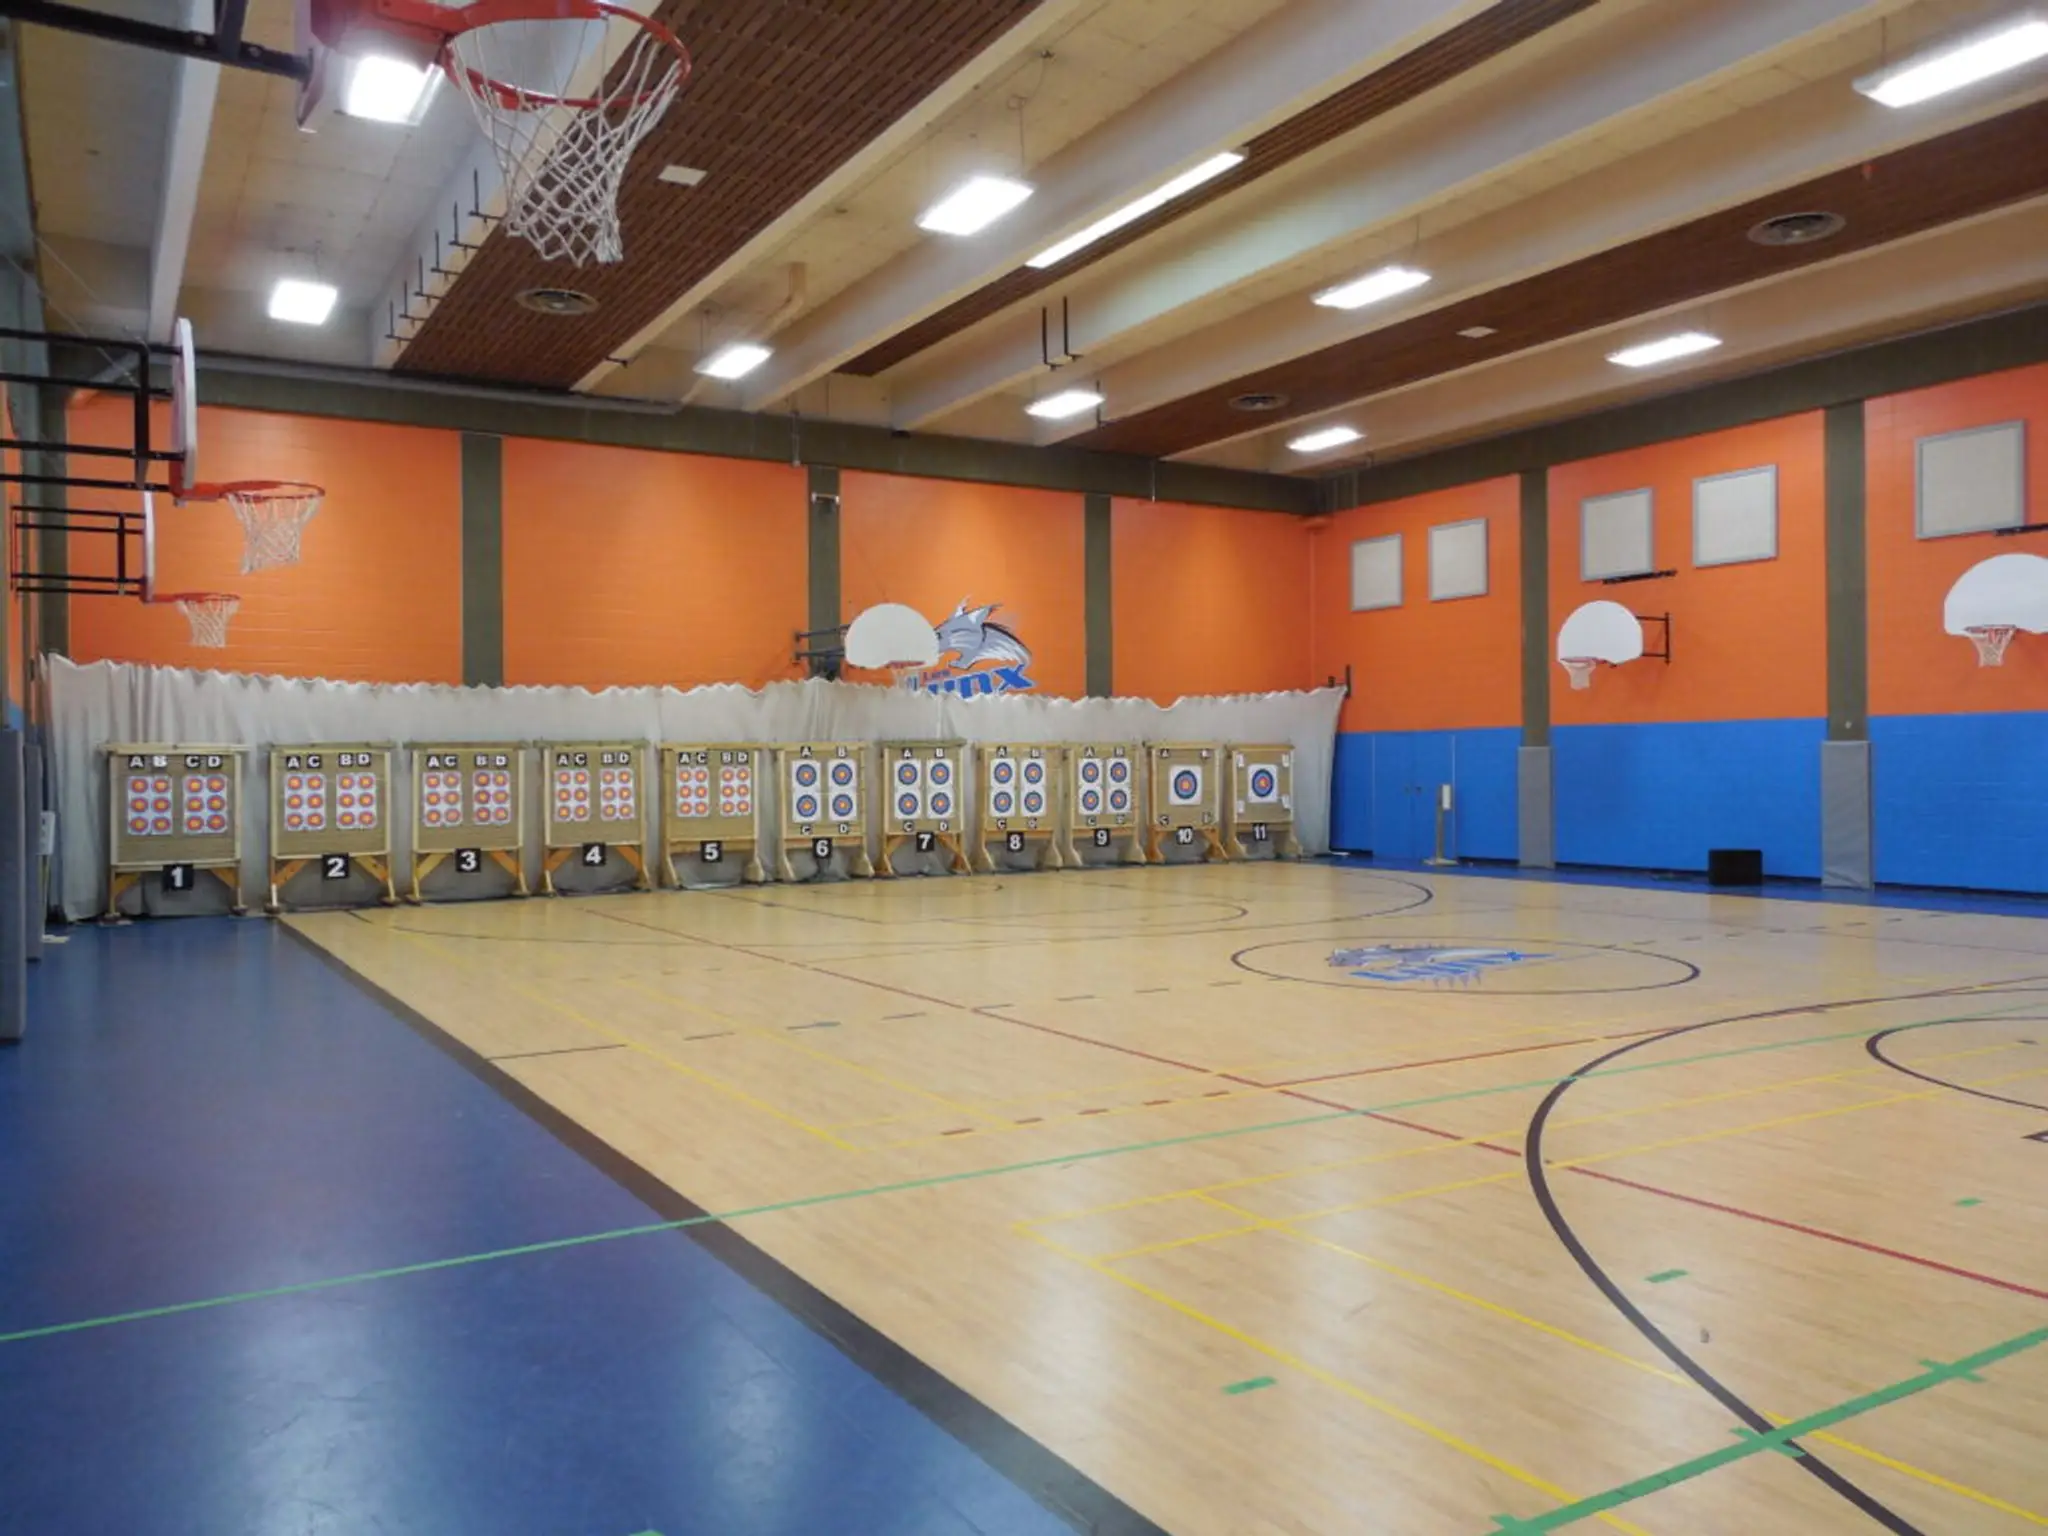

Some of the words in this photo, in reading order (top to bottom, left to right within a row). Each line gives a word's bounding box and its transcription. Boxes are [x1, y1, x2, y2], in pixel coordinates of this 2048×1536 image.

[130, 756, 143, 767] A
[153, 756, 167, 767] B
[186, 756, 199, 767] C
[208, 756, 220, 767] D
[288, 757, 299, 767] A
[308, 757, 320, 767] C
[340, 755, 352, 765] B
[358, 754, 369, 765] D
[428, 756, 439, 767] A
[444, 756, 455, 766] C
[477, 755, 486, 765] B
[495, 756, 506, 765] D
[558, 755, 568, 765] A
[575, 754, 585, 764] C
[603, 754, 612, 763] B
[619, 754, 628, 763] D
[1097, 831, 1107, 844] 9
[1178, 828, 1192, 843] 10
[1253, 826, 1266, 839] 11
[816, 840, 829, 855] 6
[919, 834, 931, 849] 7
[1010, 835, 1021, 849] 8
[585, 847, 601, 863] 4
[705, 844, 718, 860] 5
[328, 859, 345, 876] 2
[461, 852, 477, 870] 3
[171, 868, 183, 887] 1
